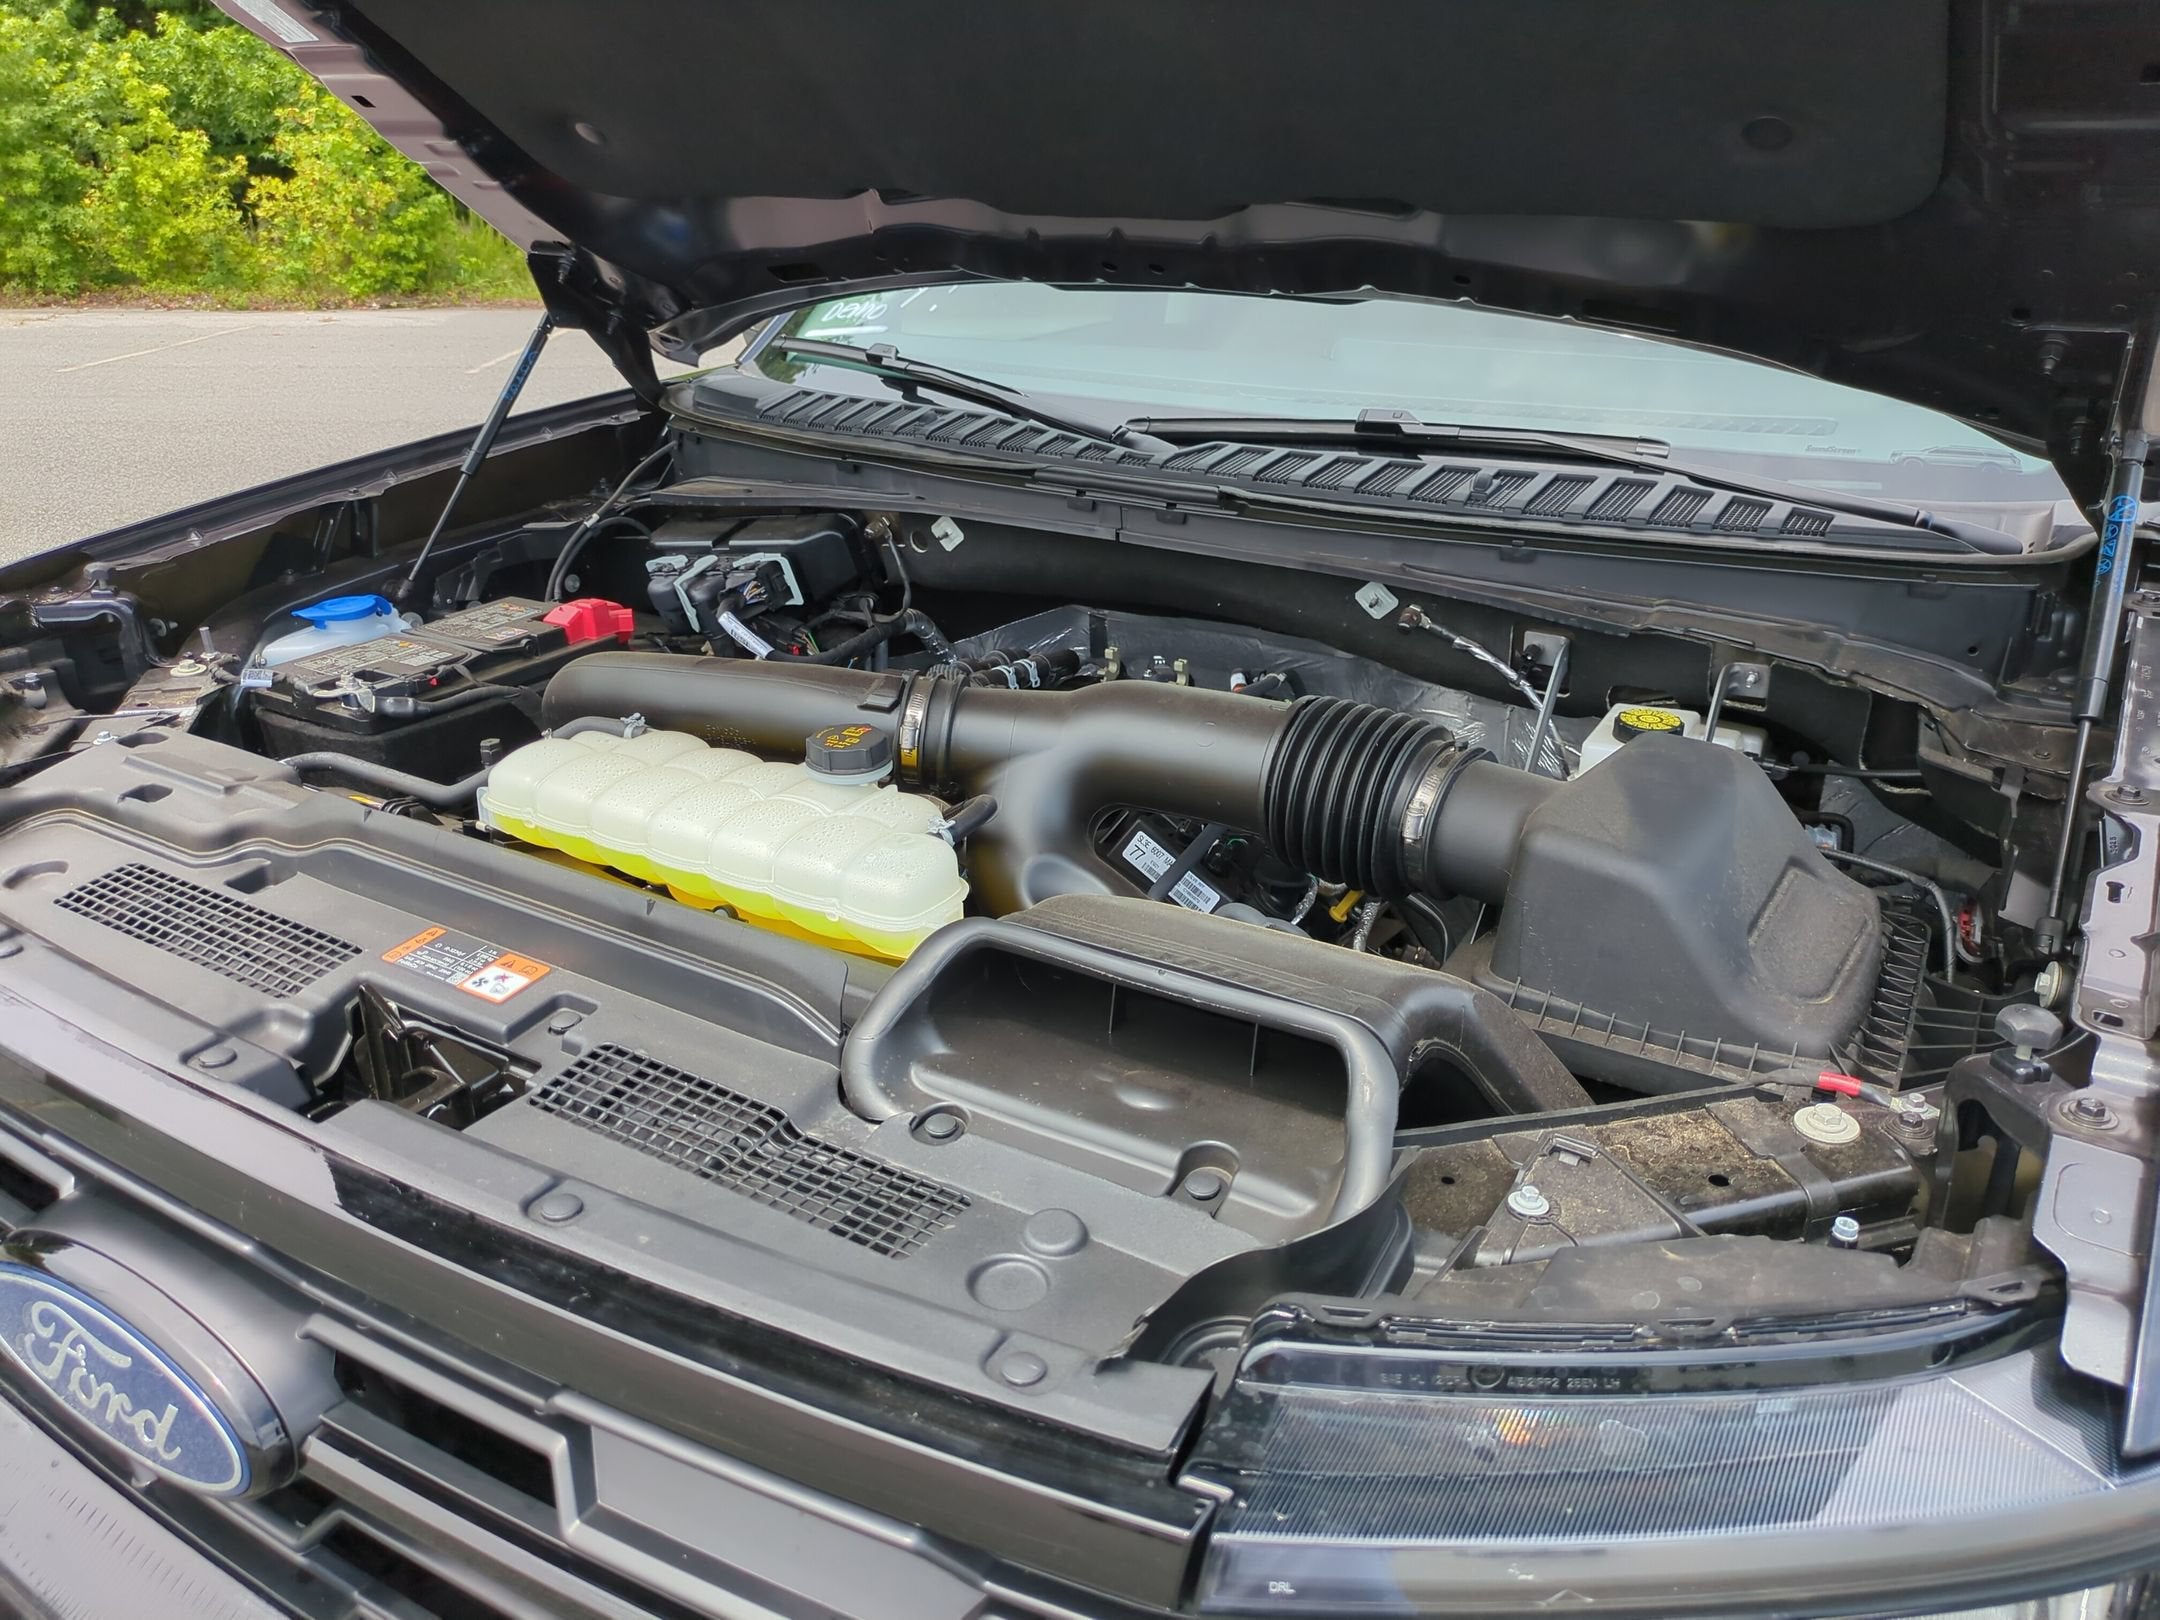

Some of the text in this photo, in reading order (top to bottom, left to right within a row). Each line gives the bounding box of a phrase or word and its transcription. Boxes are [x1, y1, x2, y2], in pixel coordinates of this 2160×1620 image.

[820, 301, 888, 322] DEMO
[1129, 844, 1146, 861] 77
[24, 1300, 182, 1461] Ford
[1268, 1581, 1296, 1594] DRL
